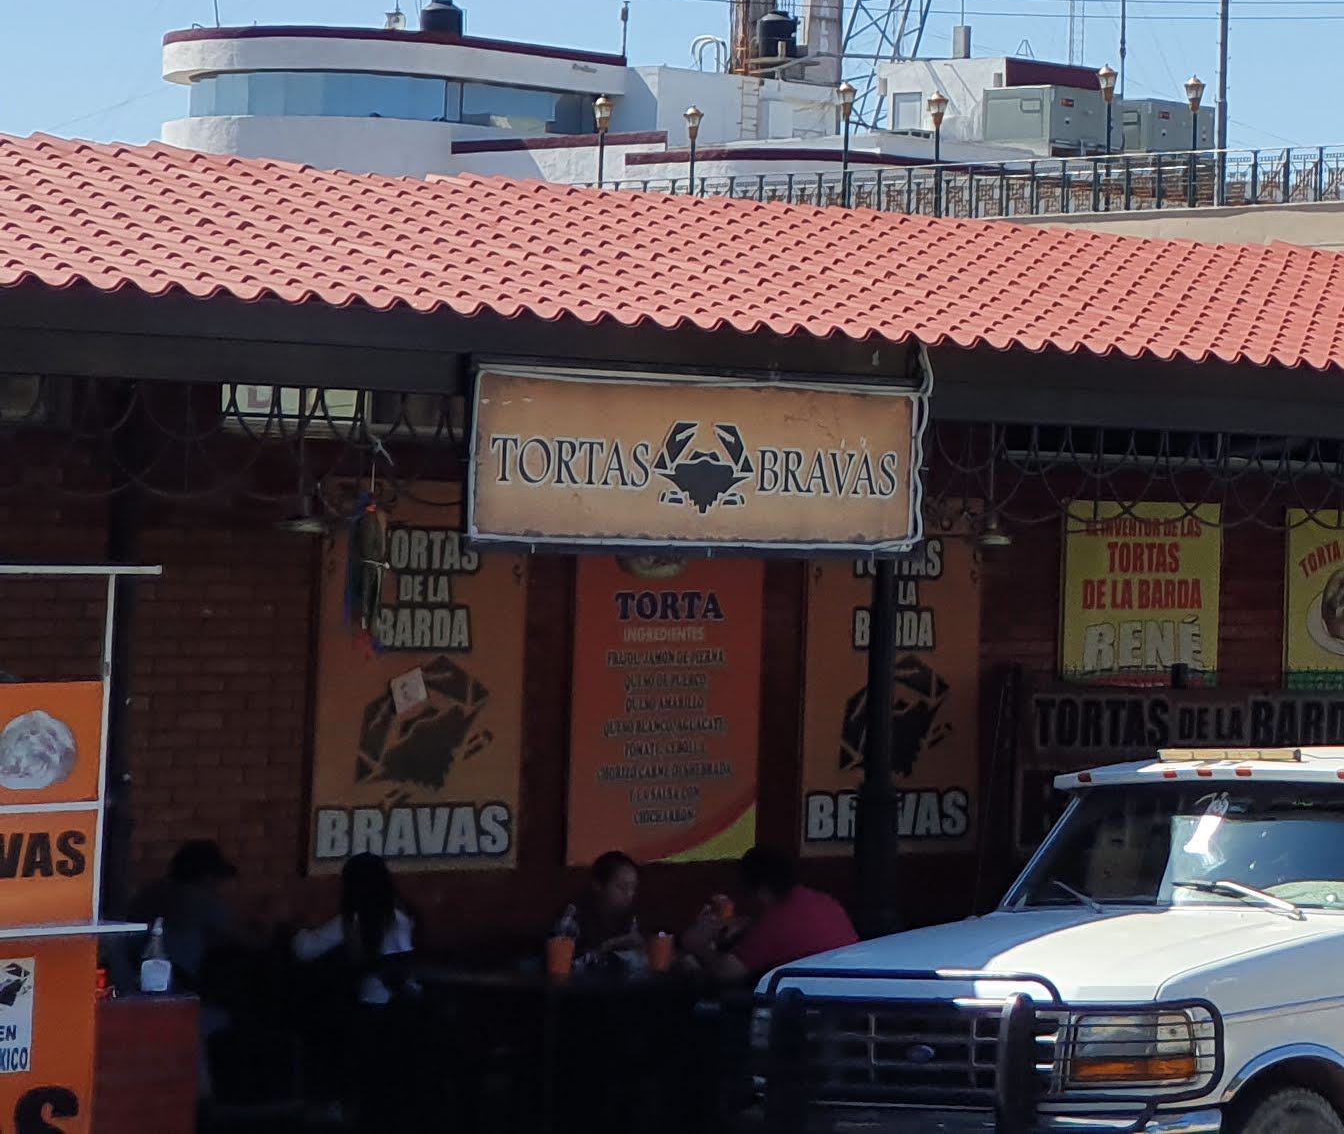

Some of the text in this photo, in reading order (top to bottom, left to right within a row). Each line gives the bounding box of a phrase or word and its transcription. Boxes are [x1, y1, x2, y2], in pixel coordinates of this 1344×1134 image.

[491, 435, 897, 497] TORTAS BRAVAS
[387, 530, 479, 571] ORTAS
[1108, 542, 1180, 573] TORTAS
[1299, 541, 1340, 578] TORTA
[400, 575, 449, 603] DE LA
[615, 591, 724, 620] TORTA
[898, 580, 918, 606] LA
[1082, 579, 1202, 610] DE LA BARDA
[378, 606, 470, 649] BARDA
[624, 625, 705, 643] INGREDIENTES
[854, 610, 934, 648] BDA
[1083, 614, 1204, 671] RENÉ
[1035, 697, 1168, 747] TORTAS
[1178, 706, 1208, 739] DE
[1216, 707, 1243, 740] LA
[316, 804, 510, 858] BRAVAS
[806, 789, 969, 839] BRVAS
